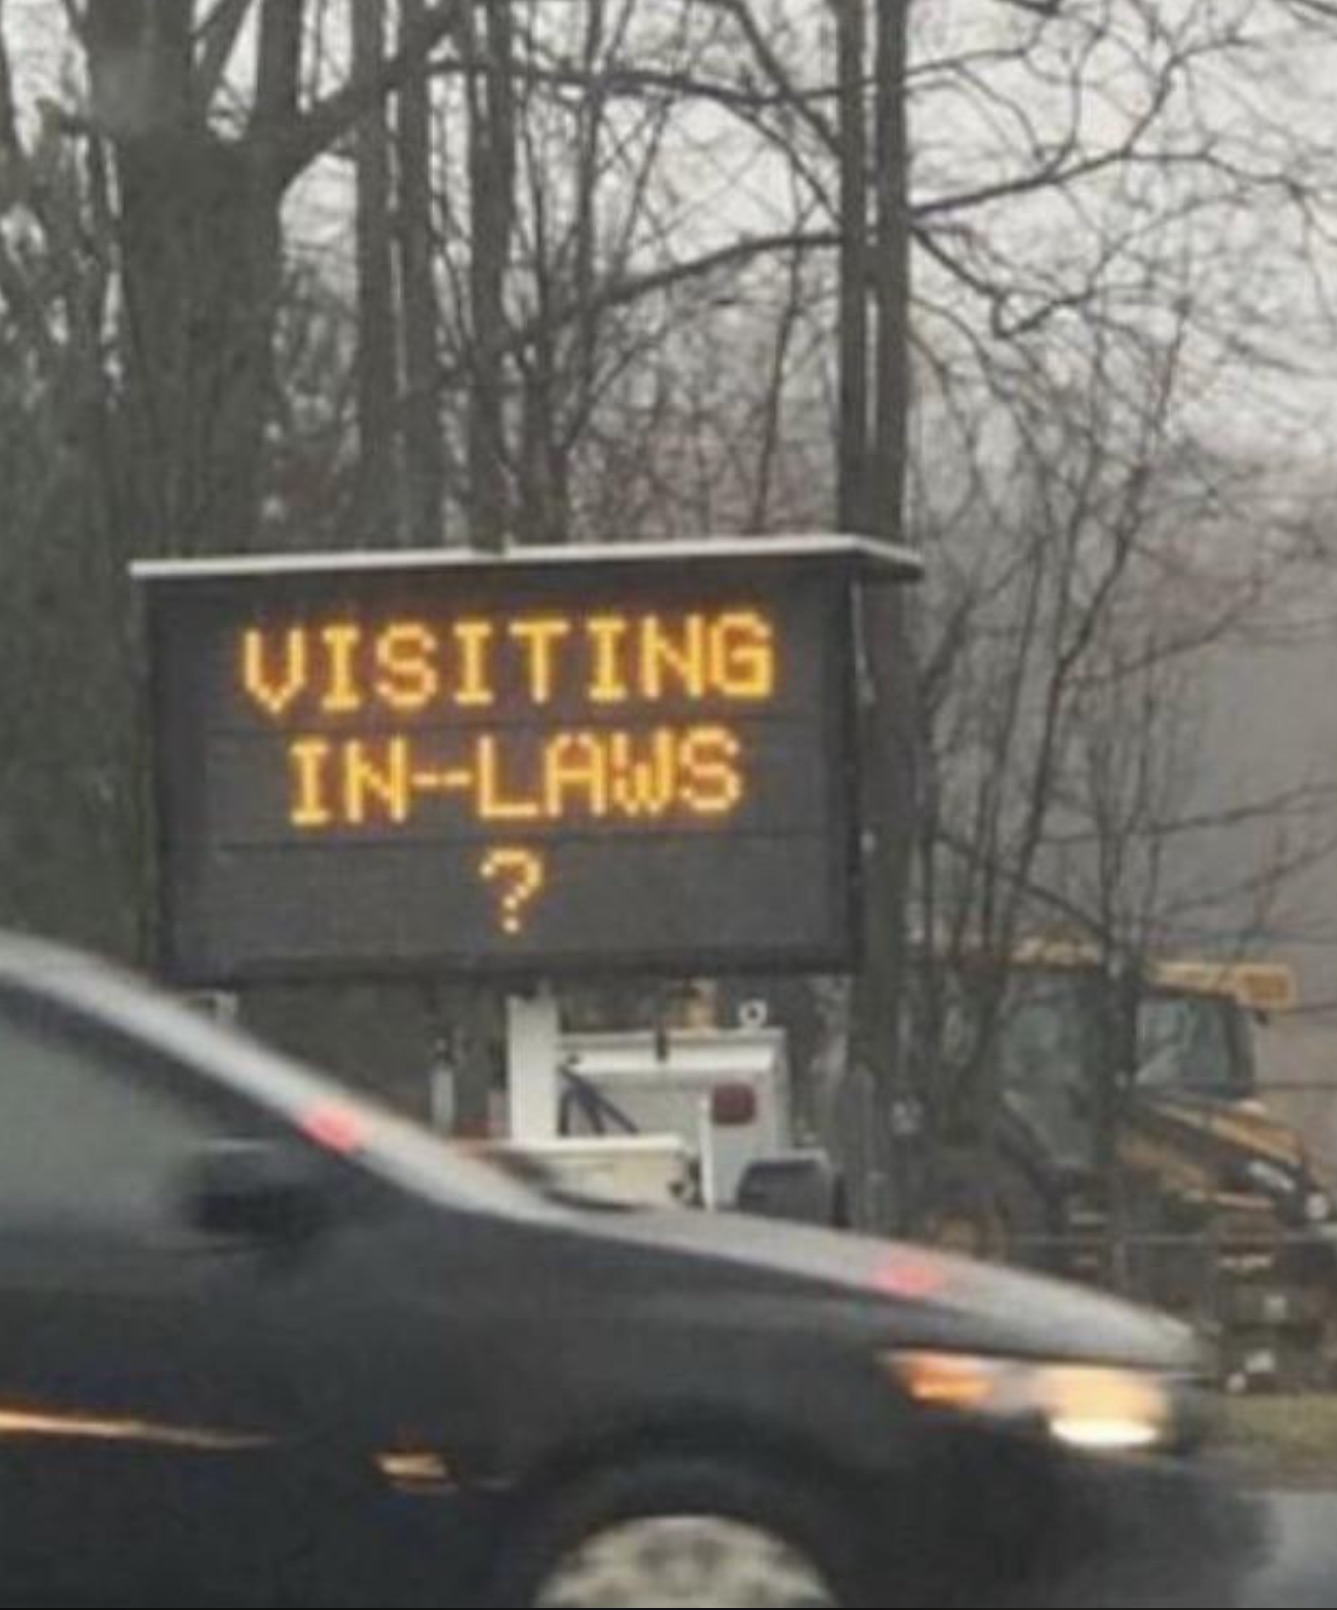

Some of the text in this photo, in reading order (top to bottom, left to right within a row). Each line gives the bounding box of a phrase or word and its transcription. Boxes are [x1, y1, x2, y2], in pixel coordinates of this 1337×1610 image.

[241, 612, 776, 714] VISITING
[290, 726, 744, 827] IN-LAWS
[479, 847, 543, 935] ?
